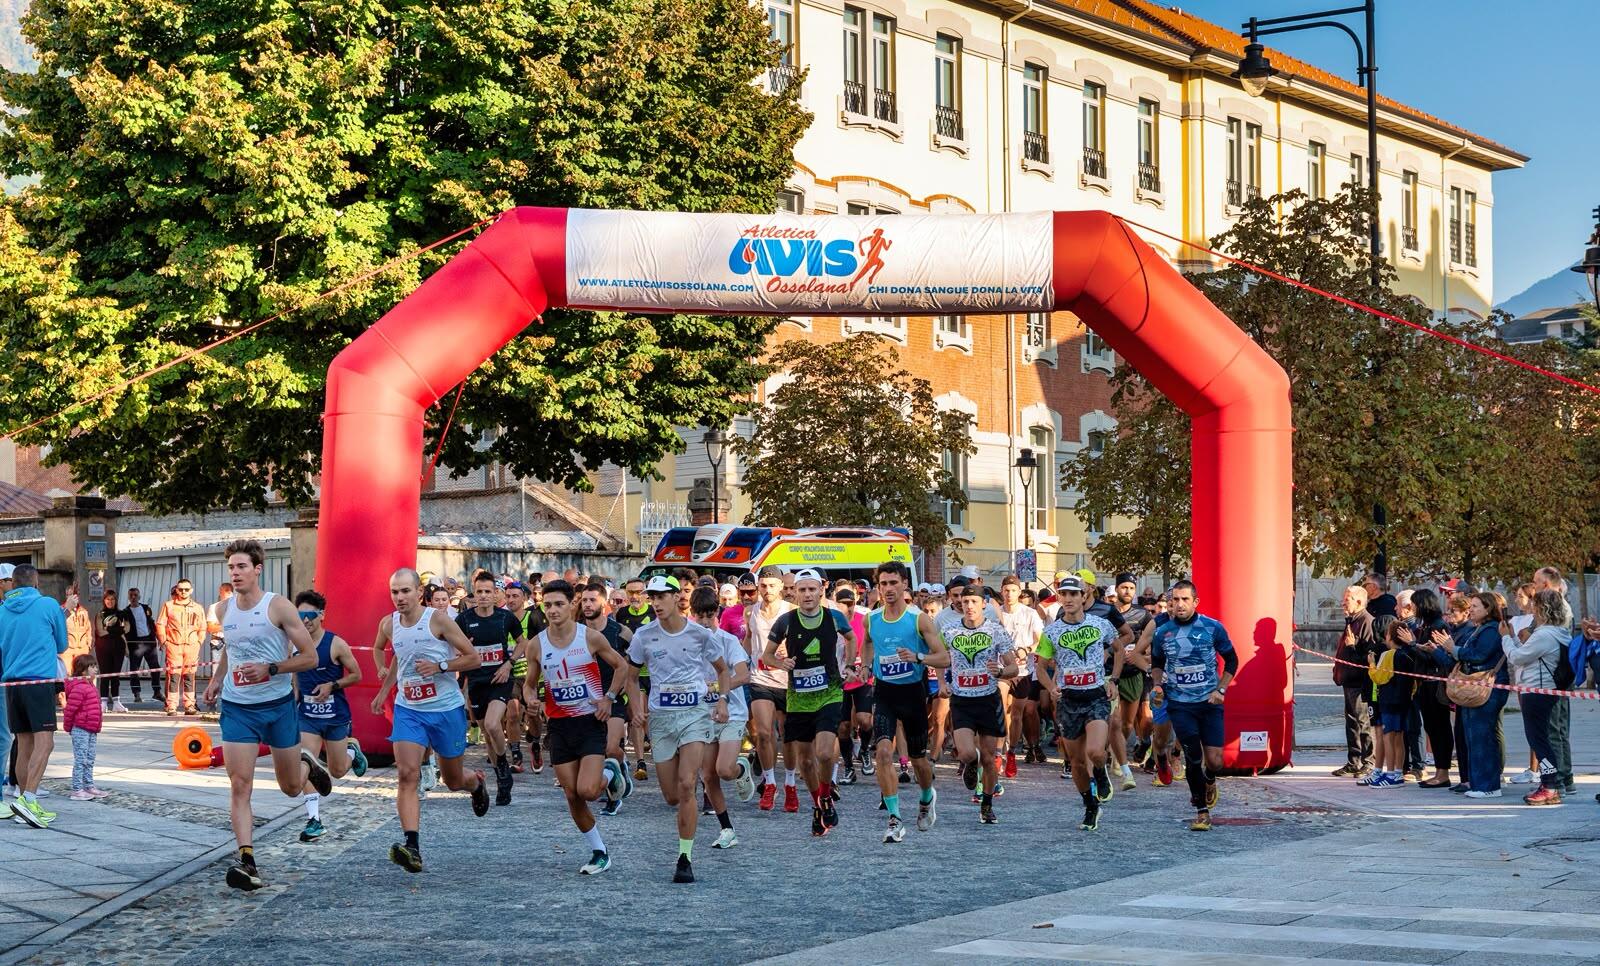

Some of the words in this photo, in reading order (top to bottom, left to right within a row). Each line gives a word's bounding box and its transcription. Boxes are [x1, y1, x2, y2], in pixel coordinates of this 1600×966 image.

[743, 224, 818, 240] Atletica
[729, 238, 858, 277] AVIS
[578, 278, 754, 293] WWW.ATLETICAVISOSSOLANA.COM
[766, 276, 850, 294] Ossolana
[868, 286, 888, 294] CHI
[890, 286, 922, 294] DONA
[924, 286, 969, 295] SANGUE
[971, 286, 1003, 294] DONA
[1005, 286, 1018, 294] LA
[1020, 286, 1043, 294] VITA
[955, 633, 987, 648] SUMMER
[1061, 627, 1096, 646] SUMMER
[492, 652, 499, 661] b
[887, 661, 908, 675] 277
[803, 674, 824, 687] 269
[963, 676, 974, 686] 27
[977, 675, 984, 685] b
[1072, 674, 1085, 685] 27
[1088, 674, 1094, 683] a
[1184, 671, 1205, 683] 246
[410, 686, 423, 698] 28
[426, 687, 434, 696] a
[560, 685, 585, 699] 289
[670, 692, 695, 705] 290
[311, 703, 333, 713] 282
